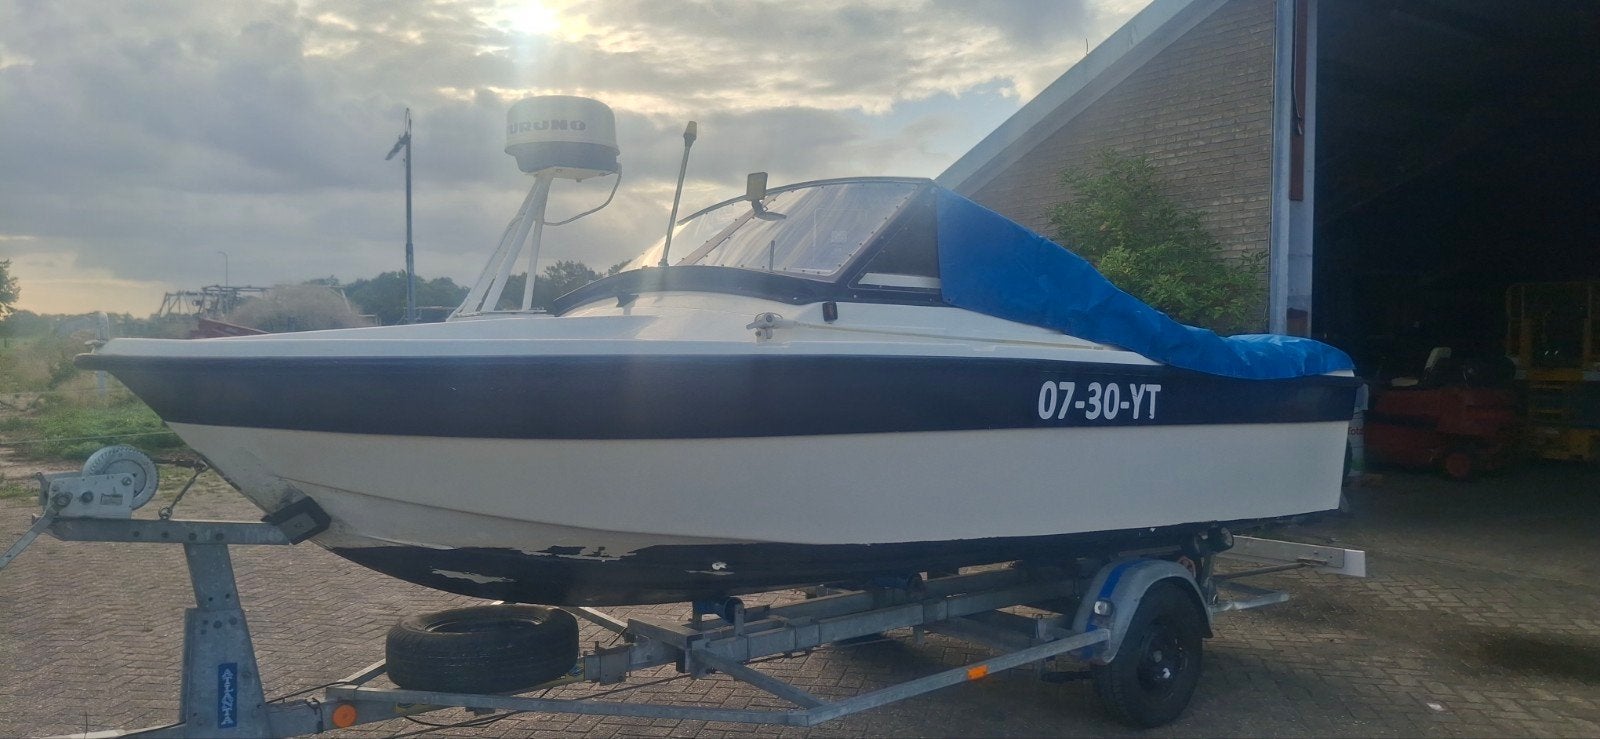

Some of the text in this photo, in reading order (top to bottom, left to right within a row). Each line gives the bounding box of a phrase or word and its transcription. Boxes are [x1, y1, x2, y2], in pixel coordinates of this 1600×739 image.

[508, 119, 587, 134] URUNO
[1038, 380, 1162, 420] 07-30-YT
[221, 668, 234, 726] ATLANTA
